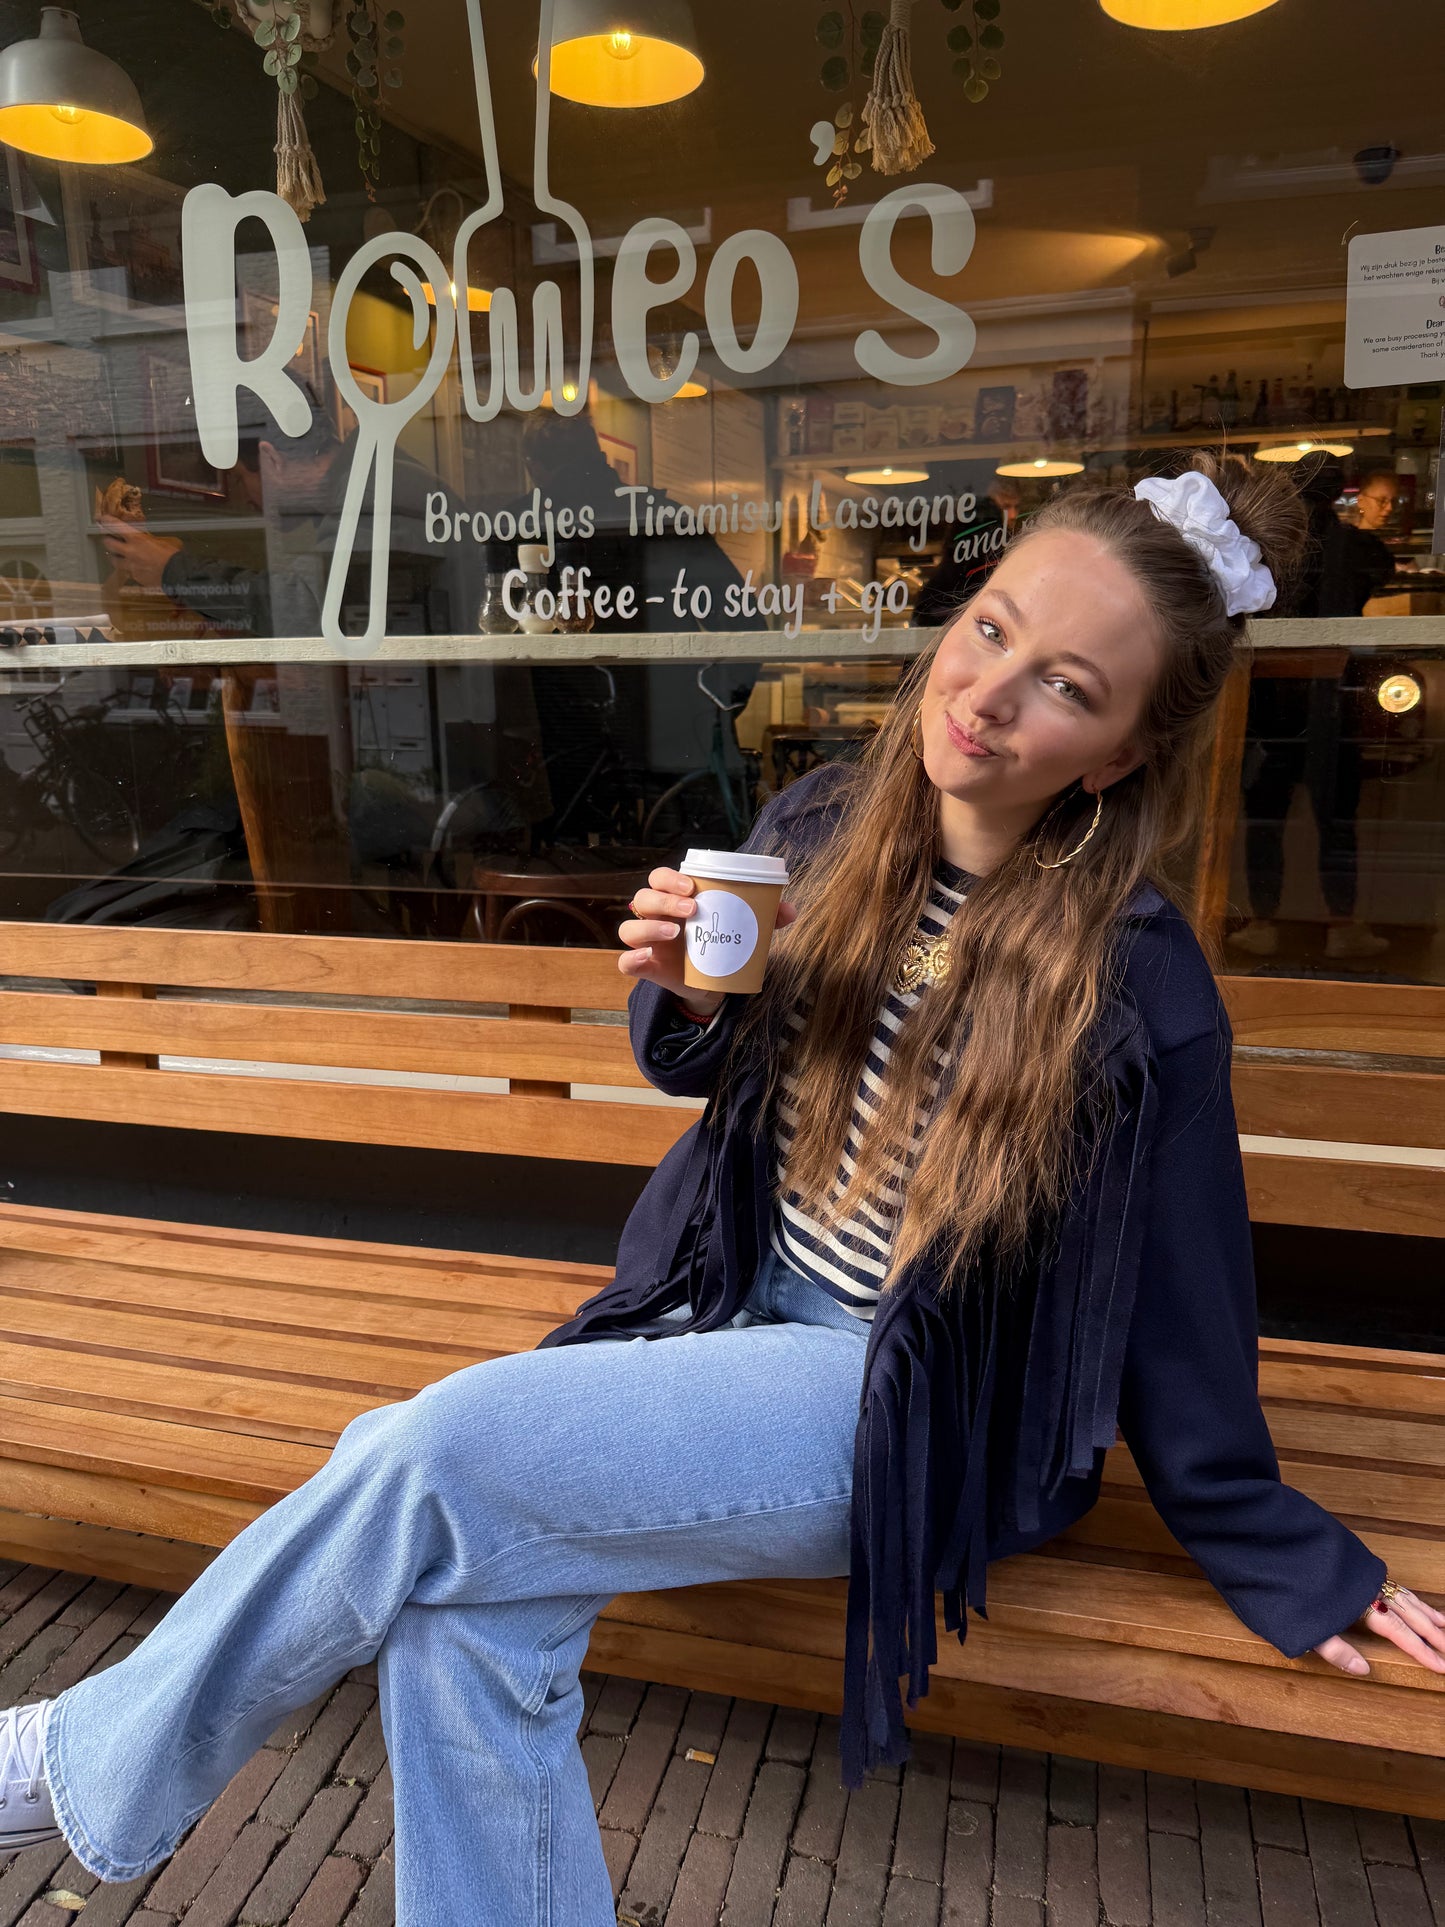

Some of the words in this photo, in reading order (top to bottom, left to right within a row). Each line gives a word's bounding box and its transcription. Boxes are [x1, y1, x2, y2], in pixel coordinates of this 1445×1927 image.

[1371, 263, 1382, 271] zijn
[1384, 260, 1397, 269] druk
[1399, 260, 1417, 268] bezig
[1418, 259, 1425, 267] je
[1376, 271, 1404, 280] wachten
[1387, 335, 1402, 343] busy
[1403, 332, 1438, 342] processing
[1390, 342, 1435, 352] consideration
[1435, 339, 1443, 347] of
[1420, 350, 1439, 358] Thank
[424, 488, 595, 567] Broodjes
[615, 485, 782, 538] Tiramisu
[809, 480, 977, 552] Lasagne
[953, 509, 1009, 564] and
[724, 568, 805, 640] stay
[861, 577, 908, 644] go
